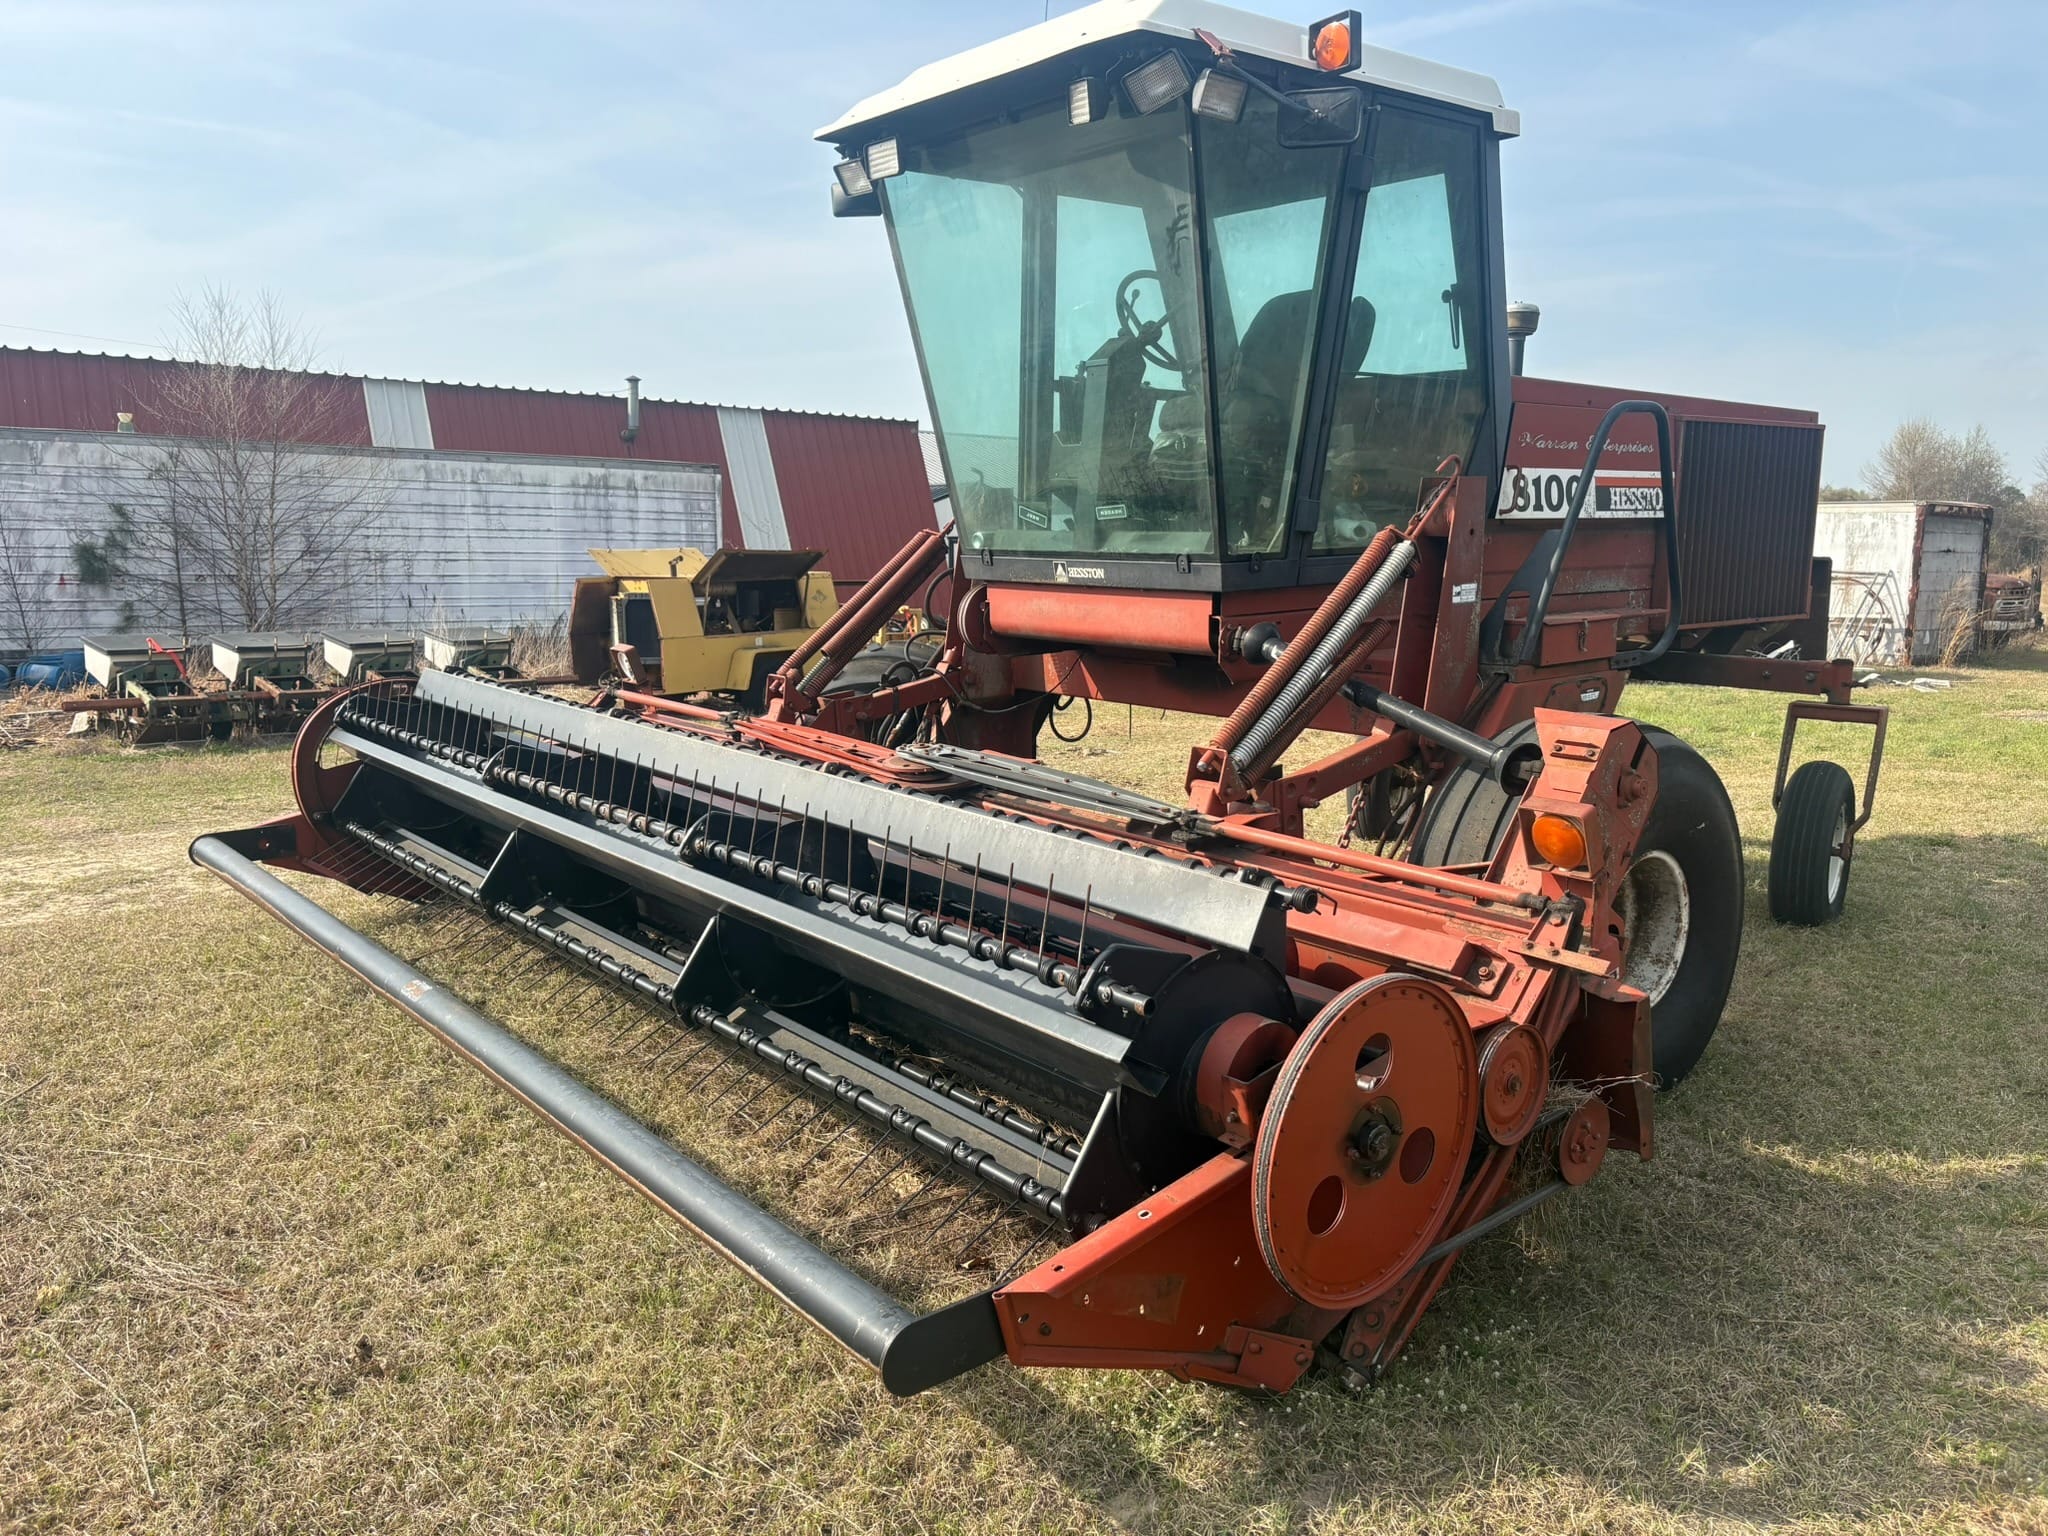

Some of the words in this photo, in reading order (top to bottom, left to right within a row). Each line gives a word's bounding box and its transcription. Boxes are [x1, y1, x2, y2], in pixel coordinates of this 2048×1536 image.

[1519, 431, 1578, 450] Warren
[1585, 434, 1655, 454] Eterprises
[1609, 486, 1665, 512] HESSTO
[1067, 566, 1105, 579] HESSTON
